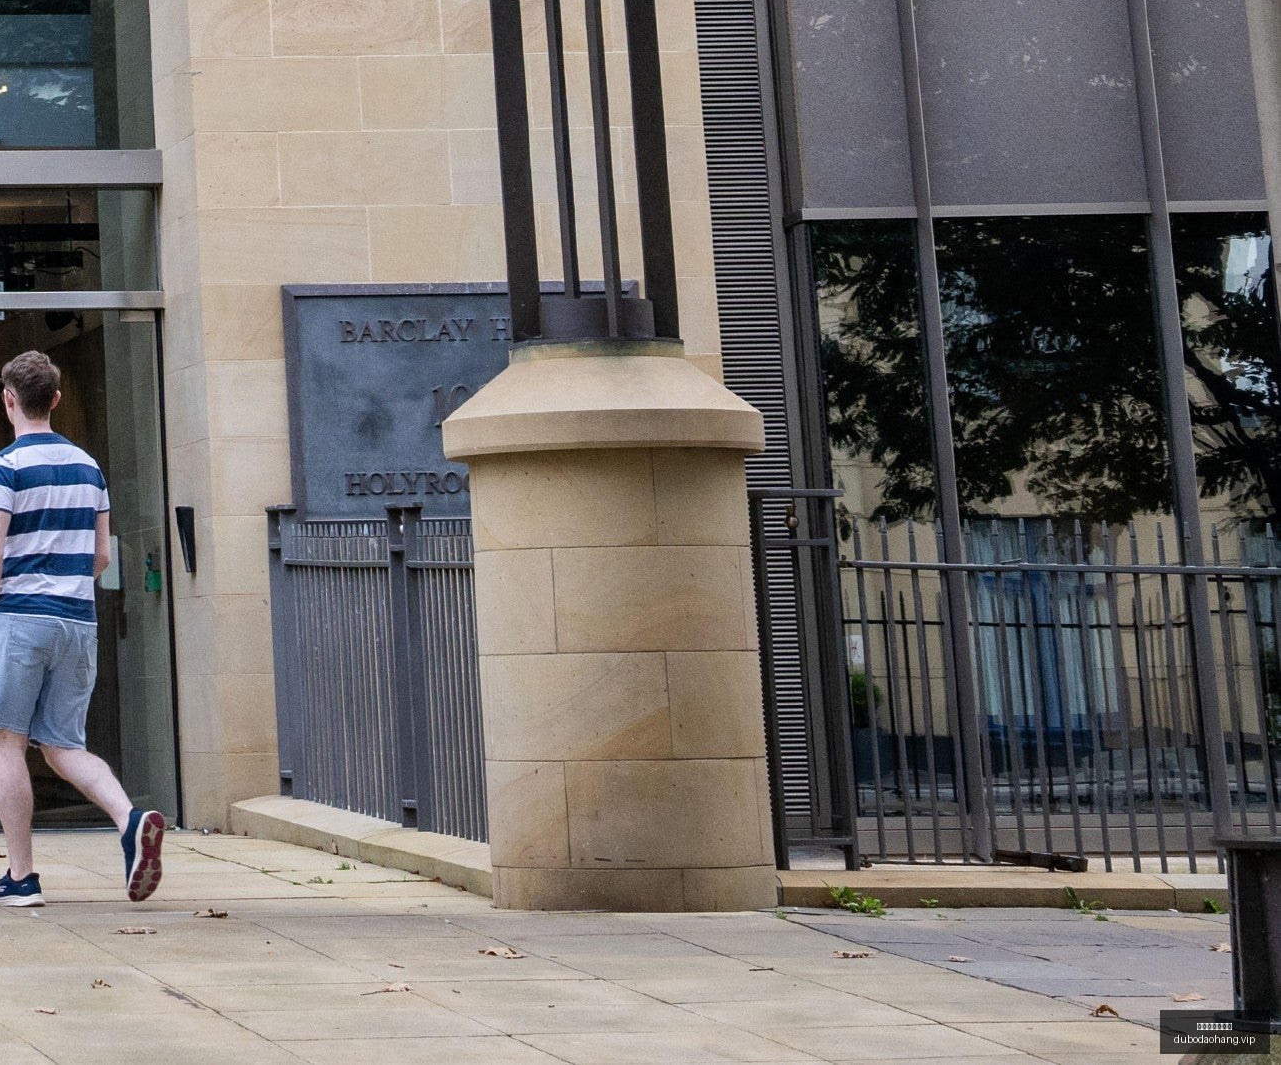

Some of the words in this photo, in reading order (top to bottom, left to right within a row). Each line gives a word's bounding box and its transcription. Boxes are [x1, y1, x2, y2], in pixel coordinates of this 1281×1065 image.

[338, 319, 474, 343] BARCLAY
[490, 318, 513, 341] H
[344, 471, 470, 496] HOLYRO
